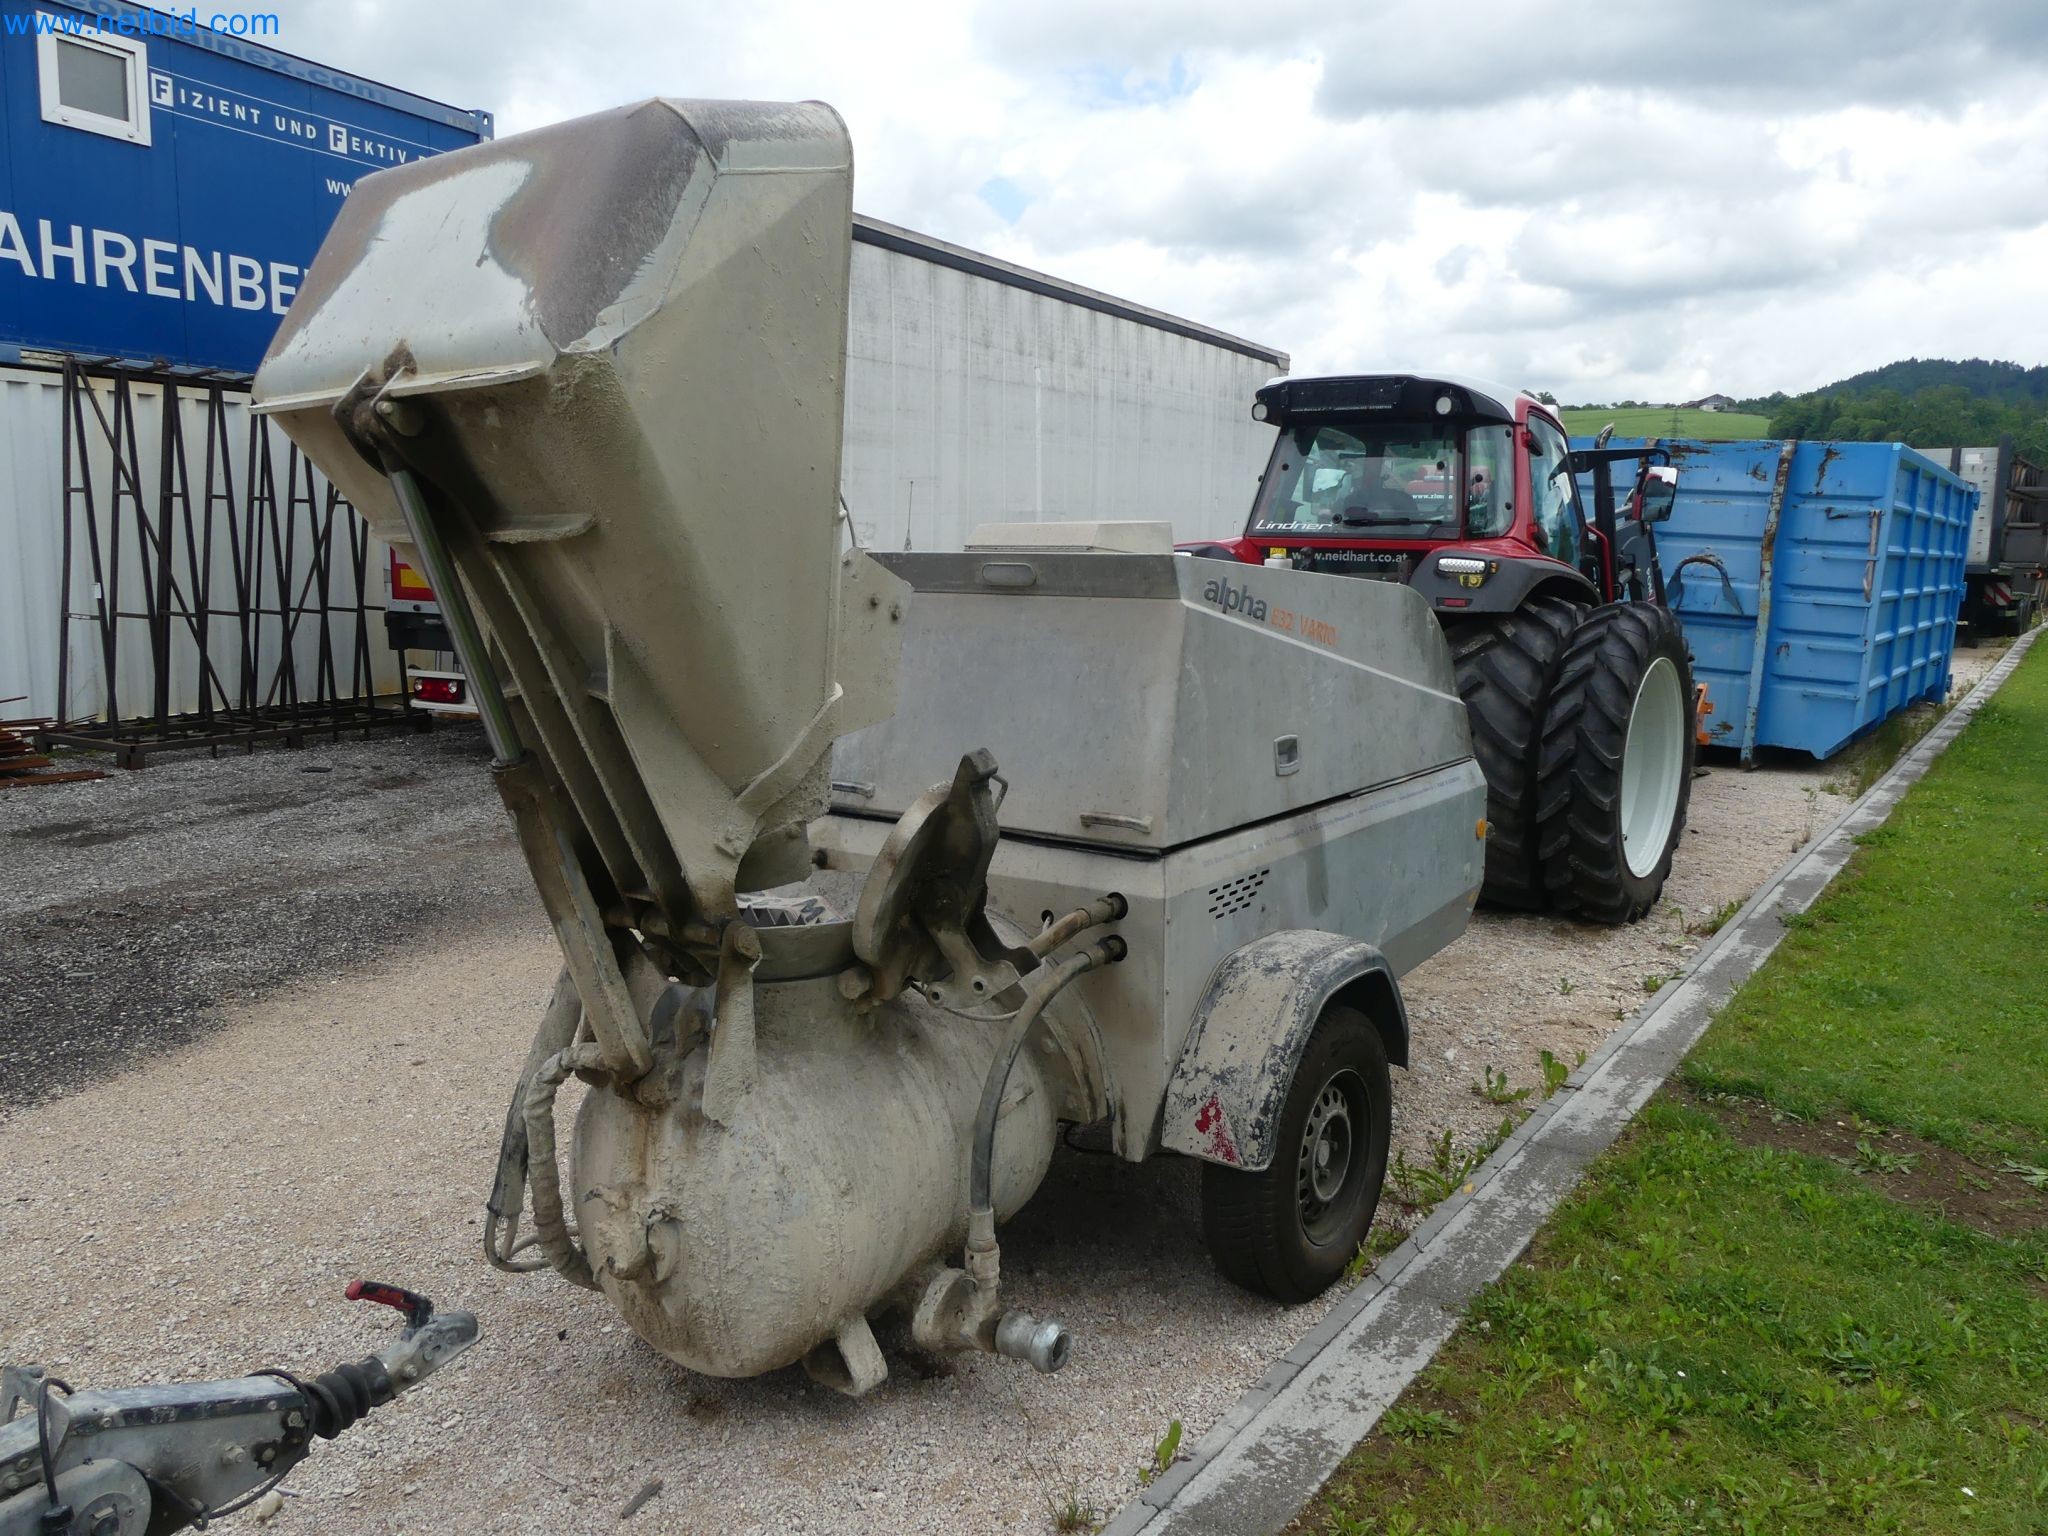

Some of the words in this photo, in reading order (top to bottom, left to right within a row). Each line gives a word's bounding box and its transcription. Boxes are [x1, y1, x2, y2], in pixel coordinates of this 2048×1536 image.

[153, 75, 261, 125] FIZIENT
[275, 116, 317, 140] UND
[331, 125, 407, 164] FEKTIV
[0, 209, 310, 316] AHRENBE
[1256, 519, 1333, 530] Lindner
[1292, 550, 1408, 563] ww.neidhart.co.at
[1203, 576, 1268, 622] alpha
